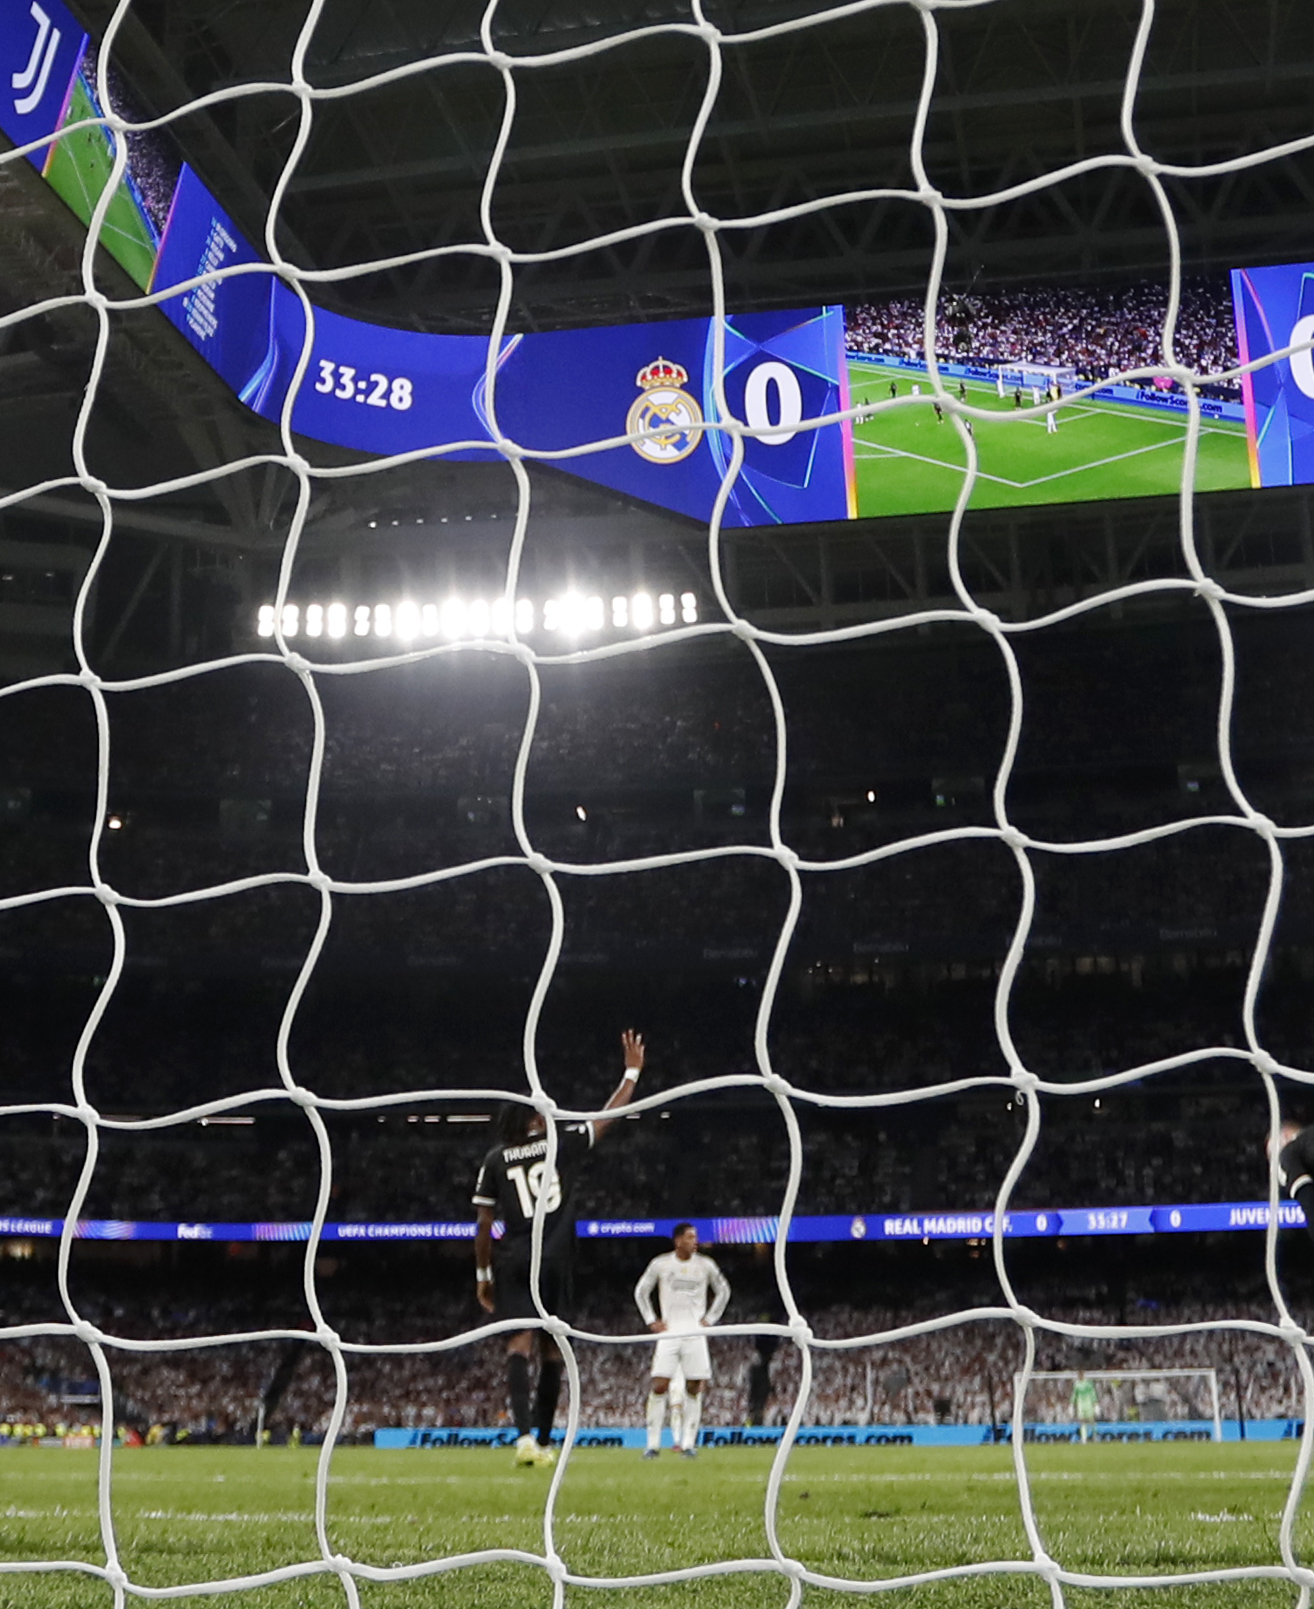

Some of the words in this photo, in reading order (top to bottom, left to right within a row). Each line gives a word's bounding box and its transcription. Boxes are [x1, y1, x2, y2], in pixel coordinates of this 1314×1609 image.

[314, 359, 414, 411] 33:28
[743, 361, 803, 446] 0
[884, 1218, 923, 1236] REAL
[924, 1215, 982, 1235] MADRID
[985, 1215, 1013, 1233] CF.
[1036, 1214, 1048, 1232] 0
[1170, 1210, 1181, 1228] 0
[338, 1225, 367, 1238] UEFA
[368, 1224, 433, 1238] CHAMPIONS
[434, 1224, 477, 1237] LEAGUE
[601, 1222, 656, 1236] crypto.com
